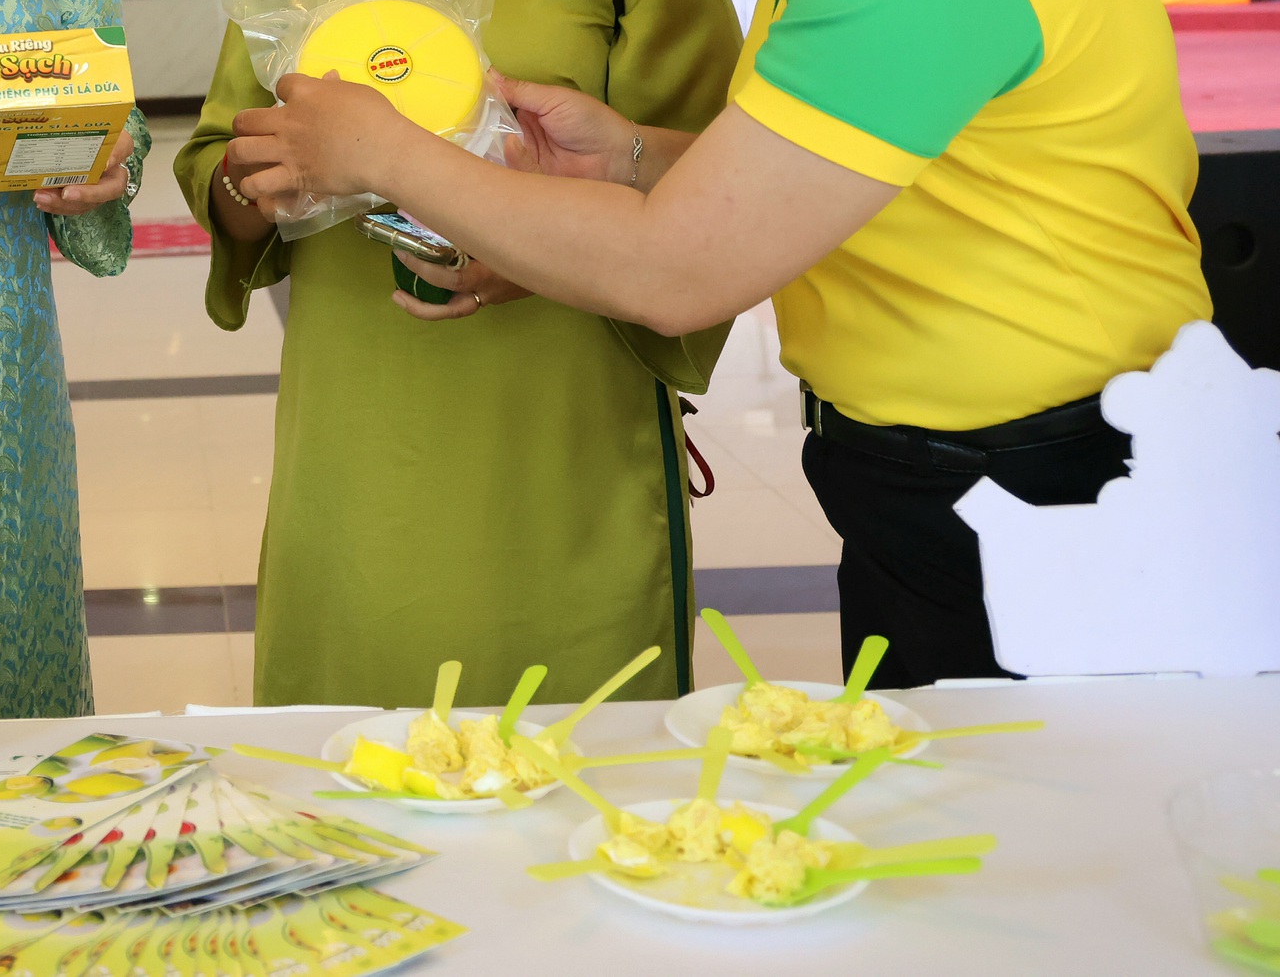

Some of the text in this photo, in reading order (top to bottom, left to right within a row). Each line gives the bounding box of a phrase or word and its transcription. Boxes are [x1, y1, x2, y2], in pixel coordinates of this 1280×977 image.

[10, 39, 53, 52] Riêng
[0, 53, 73, 83] Sạch
[379, 57, 408, 69] SẠCH
[63, 84, 73, 95] SĨ
[77, 83, 91, 94] LÁ
[95, 81, 120, 93] DỨA
